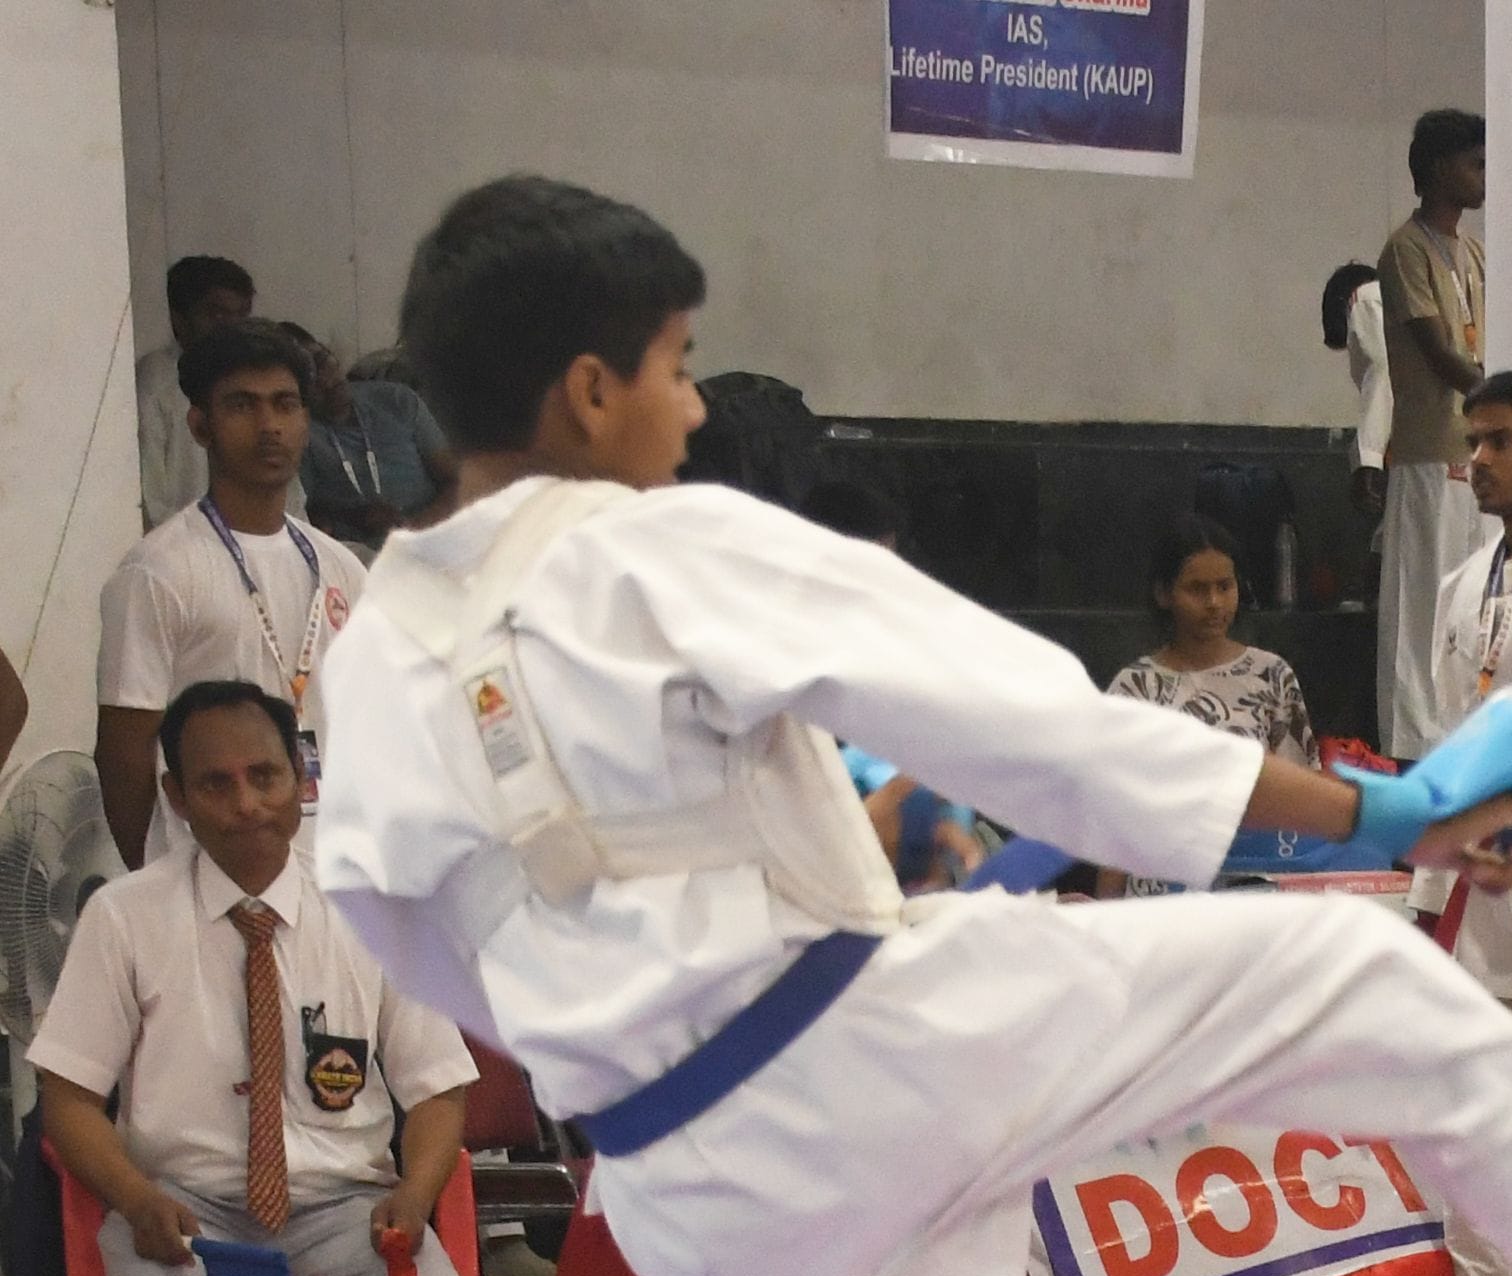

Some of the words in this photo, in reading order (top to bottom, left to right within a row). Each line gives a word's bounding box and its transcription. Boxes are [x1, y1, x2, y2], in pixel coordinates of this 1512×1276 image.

[1007, 13, 1048, 50] IAS,
[890, 46, 973, 83] Lifetime
[980, 54, 1078, 92] President
[1084, 64, 1153, 104] (KAUP)
